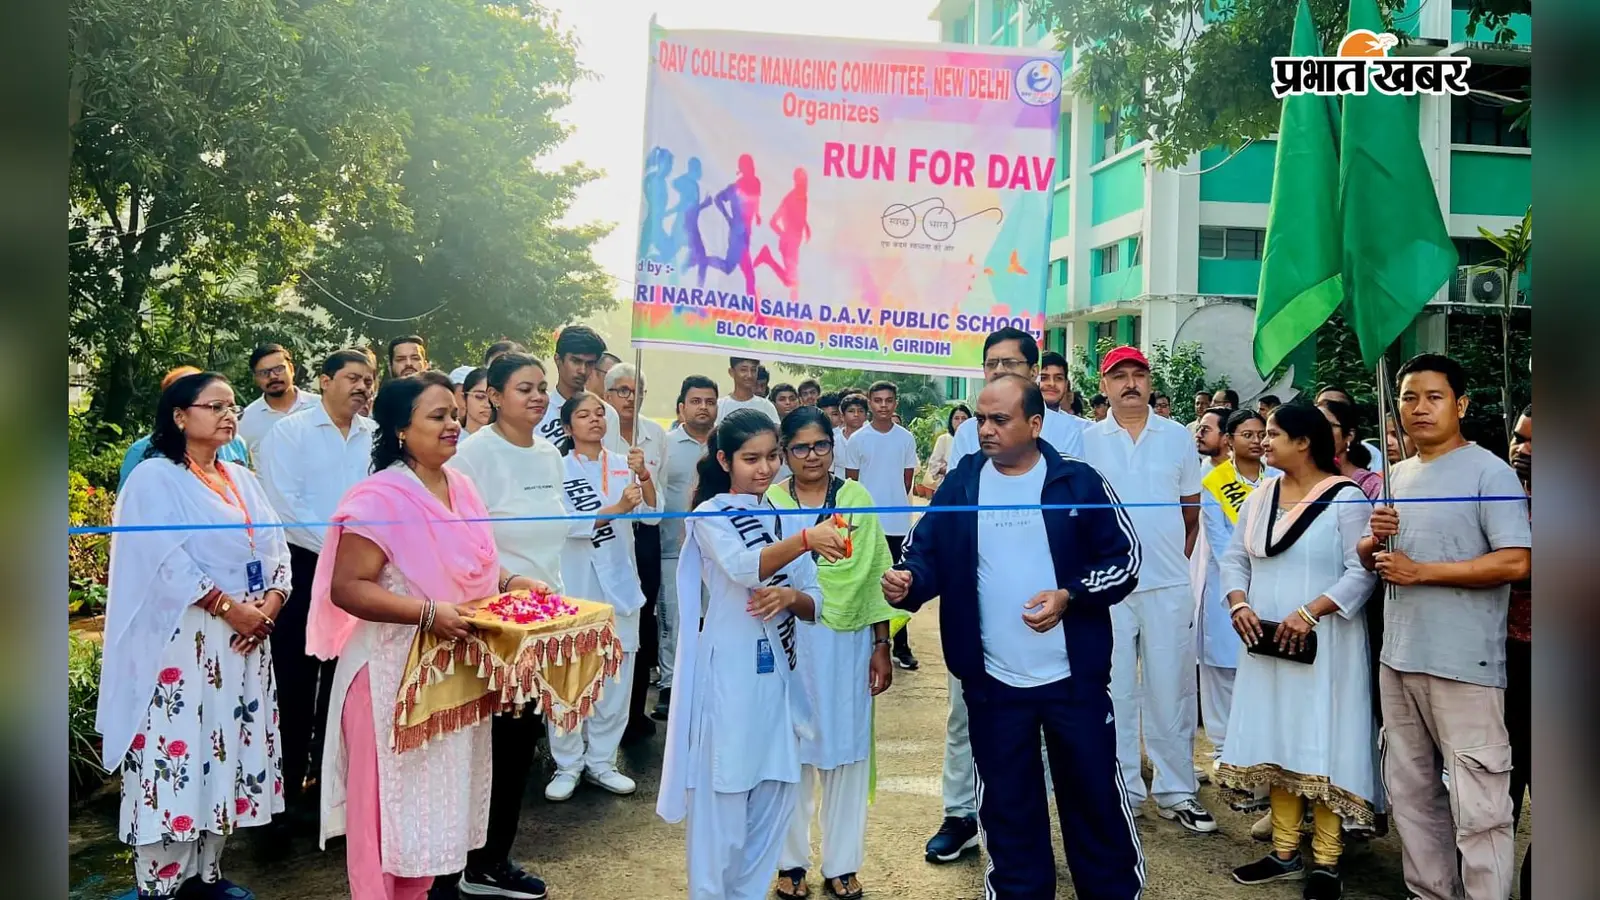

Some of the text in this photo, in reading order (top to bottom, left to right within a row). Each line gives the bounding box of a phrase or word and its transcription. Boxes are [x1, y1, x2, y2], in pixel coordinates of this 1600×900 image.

[659, 40, 1011, 102] DAV COLLEGE MANAGING COMMITTEE, NEW DELHI
[783, 91, 880, 126] Organizes
[823, 142, 1056, 191] RUN FOR DAV
[929, 220, 949, 229] भारत
[647, 261, 662, 276] by
[662, 286, 754, 313] NARAYAN
[760, 299, 813, 321] SAHA
[819, 305, 873, 325] D.A.V.
[879, 310, 950, 330] PUBLIC
[955, 315, 1042, 339] SCHOOL,
[716, 321, 768, 341] BLOCK
[773, 329, 815, 346] ROAD
[828, 334, 879, 351] SIRSIA
[893, 338, 951, 356] GIRIDIH
[563, 478, 602, 511] HEAD
[777, 615, 798, 671] HEAD
